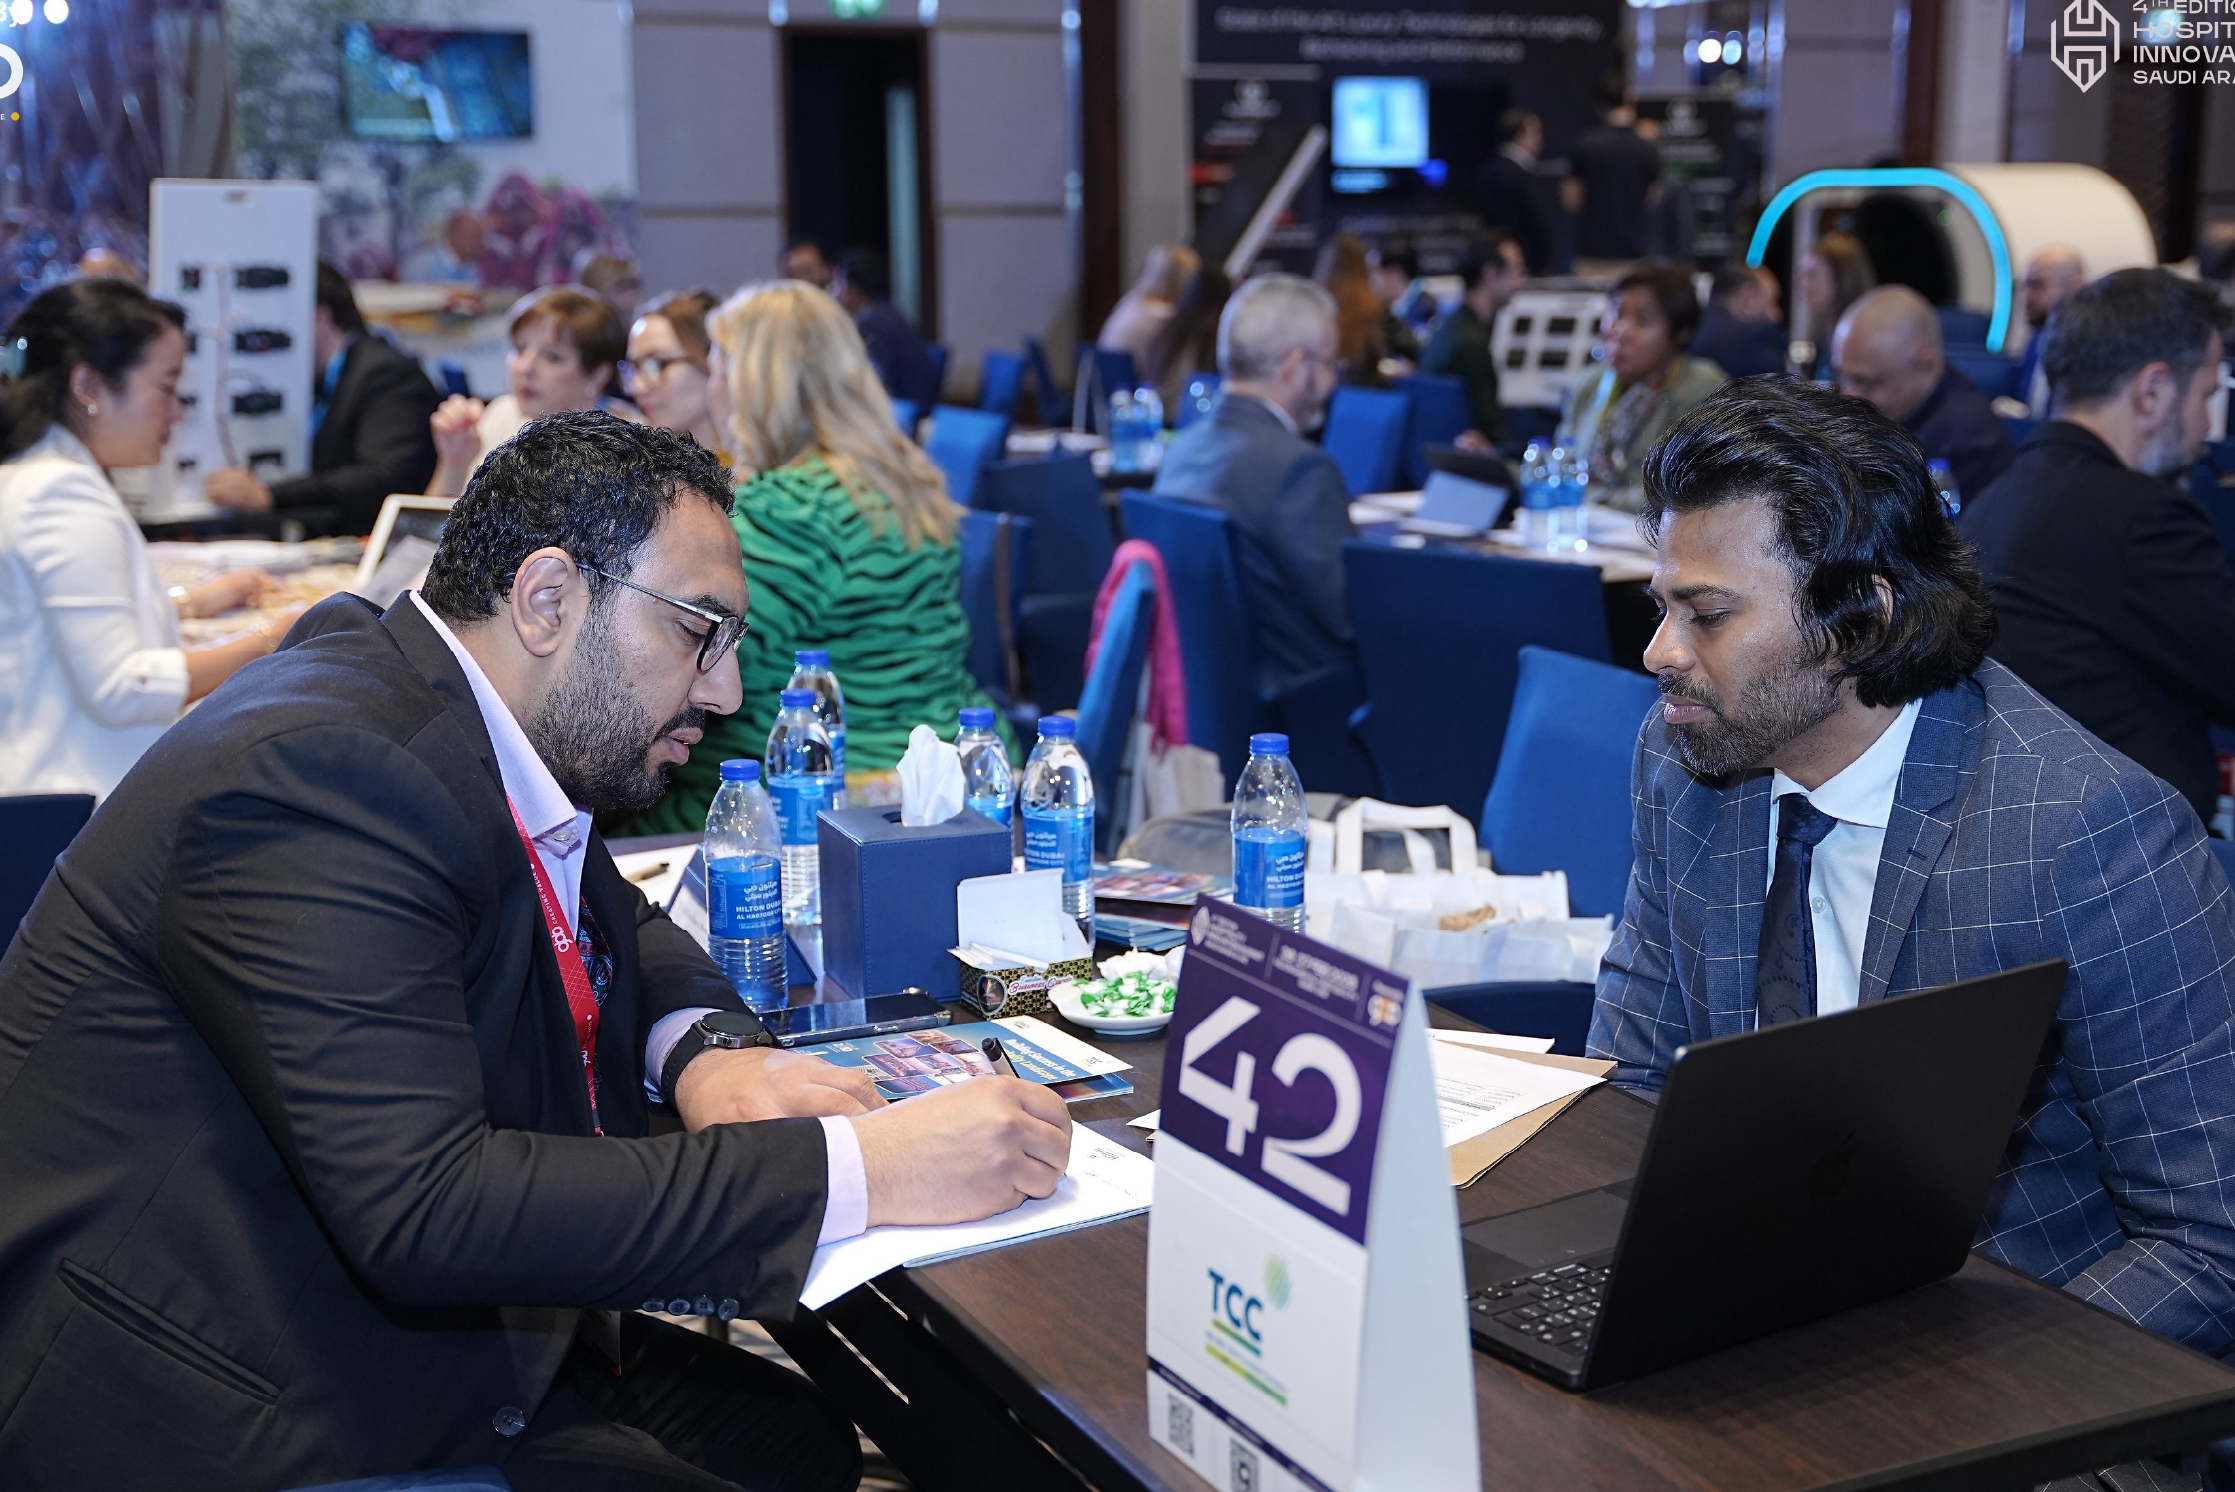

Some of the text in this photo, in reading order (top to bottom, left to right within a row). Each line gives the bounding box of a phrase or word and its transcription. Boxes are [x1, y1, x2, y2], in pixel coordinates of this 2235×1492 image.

[541, 893, 558, 925] CREATING
[1178, 994, 1363, 1218] 42
[1207, 1268, 1263, 1342] TCC
